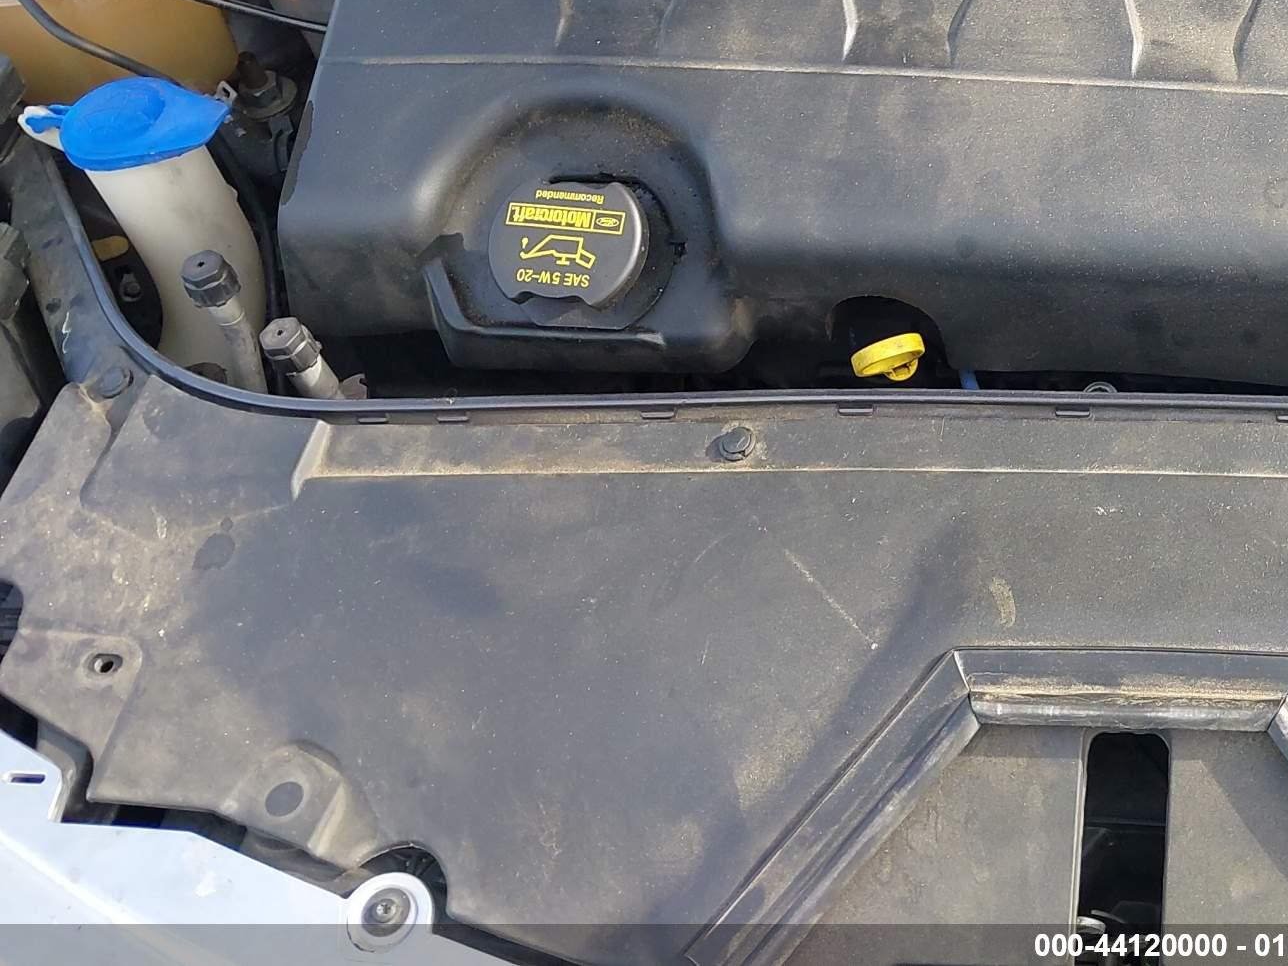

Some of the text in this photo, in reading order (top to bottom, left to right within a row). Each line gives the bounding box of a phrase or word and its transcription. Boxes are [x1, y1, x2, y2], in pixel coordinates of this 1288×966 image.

[535, 188, 605, 205] Recommended
[511, 205, 592, 228] Motorcraft
[516, 268, 591, 288] SAE 5W-20
